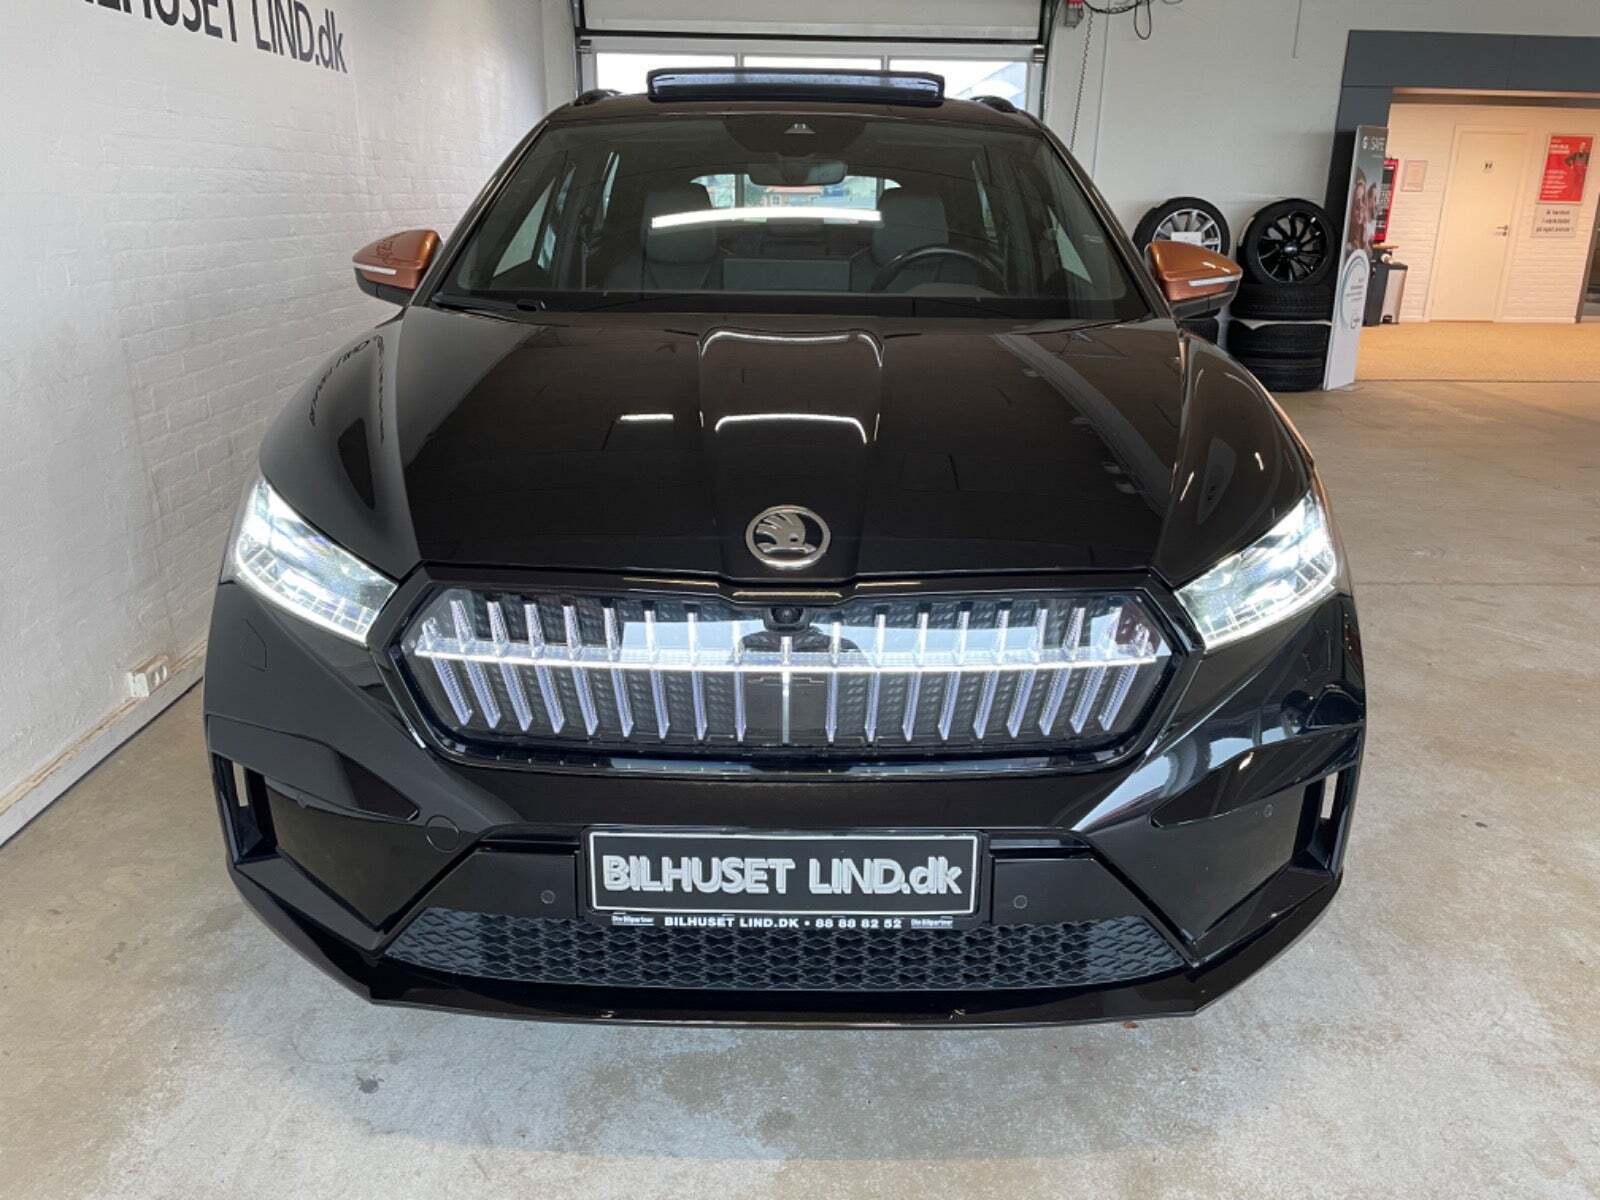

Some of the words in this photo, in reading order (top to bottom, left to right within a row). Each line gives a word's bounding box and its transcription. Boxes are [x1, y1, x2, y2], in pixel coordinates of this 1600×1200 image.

[250, 0, 348, 74] LIND.dk
[602, 855, 795, 894] BILHUSET
[808, 856, 963, 895] LIND.dk
[664, 916, 736, 928] BILHUSET
[739, 917, 799, 929] LIND.DK
